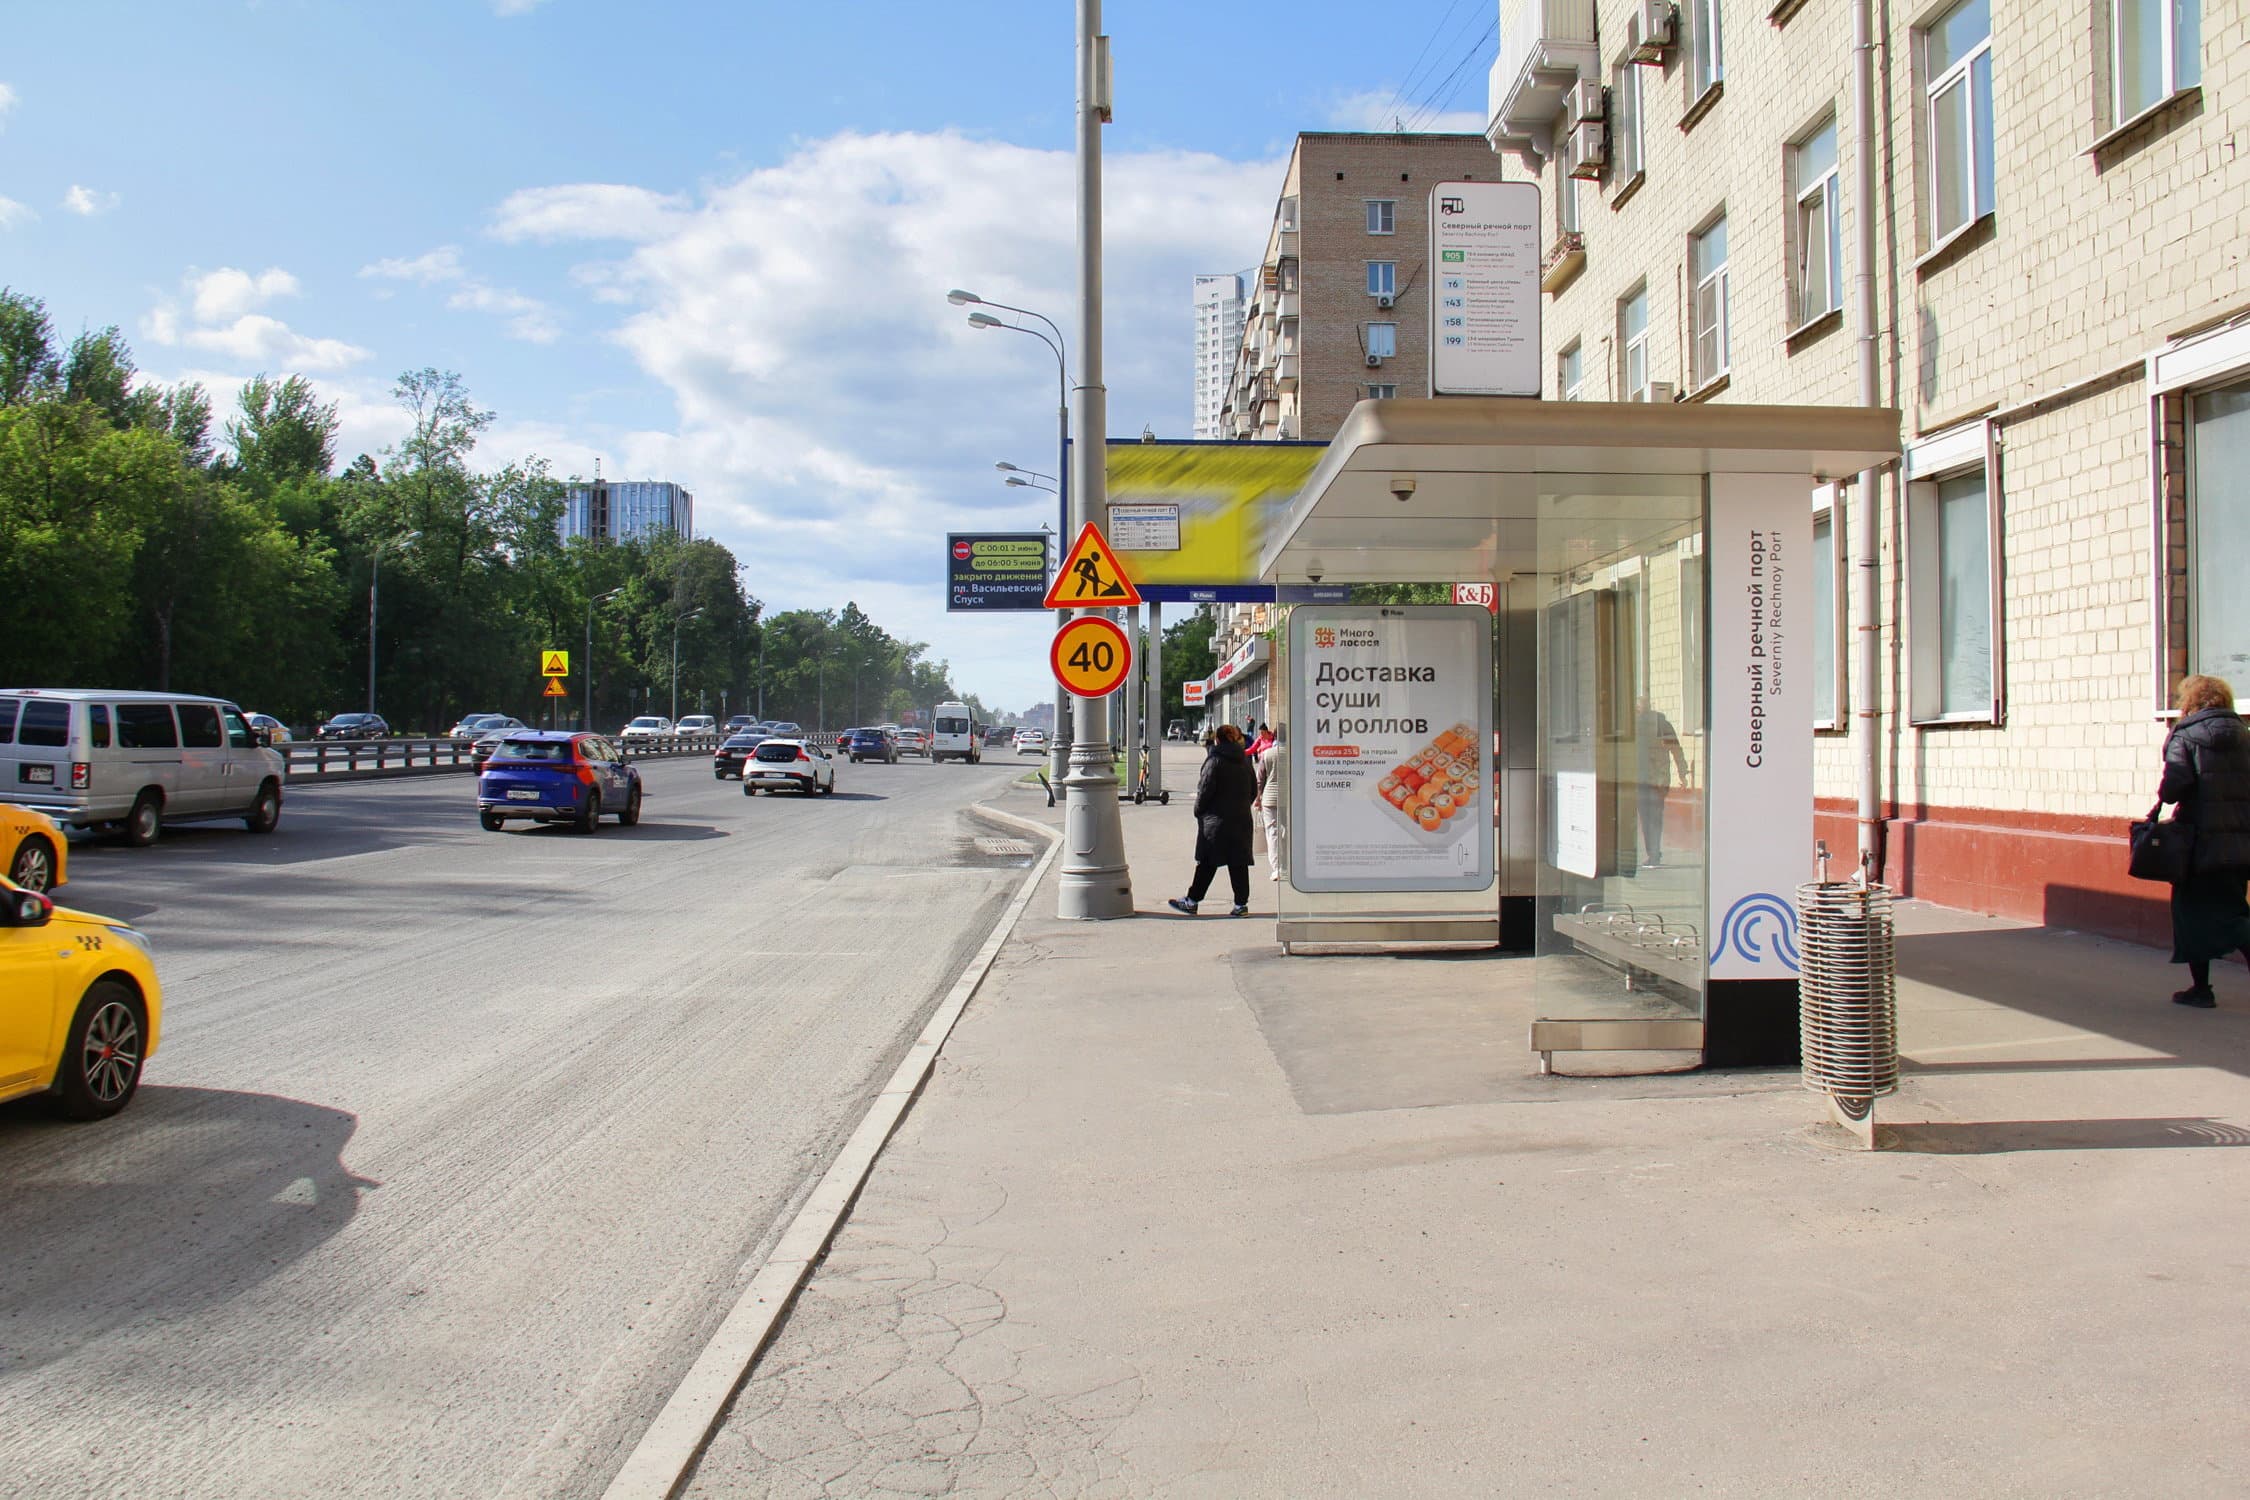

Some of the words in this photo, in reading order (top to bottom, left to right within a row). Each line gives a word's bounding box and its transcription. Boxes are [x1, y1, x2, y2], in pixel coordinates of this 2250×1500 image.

[1441, 222, 1482, 230] Северный
[1483, 222, 1512, 231] речной
[1513, 223, 1532, 231] порт
[1445, 252, 1460, 260] 905
[1448, 280, 1458, 288] т6
[1445, 298, 1461, 307] т43
[1445, 318, 1461, 326] т58
[1446, 336, 1461, 345] 199
[1769, 531, 1782, 561] Port
[1751, 530, 1766, 577] порт
[987, 559, 1011, 567] 06:00
[1013, 559, 1018, 567] 5
[953, 573, 993, 582] закрыто
[995, 573, 1043, 582] движение
[953, 585, 969, 593] пл.
[971, 583, 1043, 593] Васильевский
[953, 594, 984, 605] Спуск
[1769, 566, 1784, 627] Rechnoy
[1746, 584, 1766, 657] речной
[1340, 629, 1374, 638] Много
[1339, 639, 1380, 647] лосося
[1068, 641, 1114, 672] 40
[1769, 632, 1784, 695] Severniy
[1315, 661, 1436, 687] Доставка
[1316, 692, 1381, 713] суши
[1746, 664, 1766, 768] Северный
[1316, 718, 1330, 734] и
[1338, 718, 1429, 739] роллов
[1315, 781, 1352, 789] SUMMER
